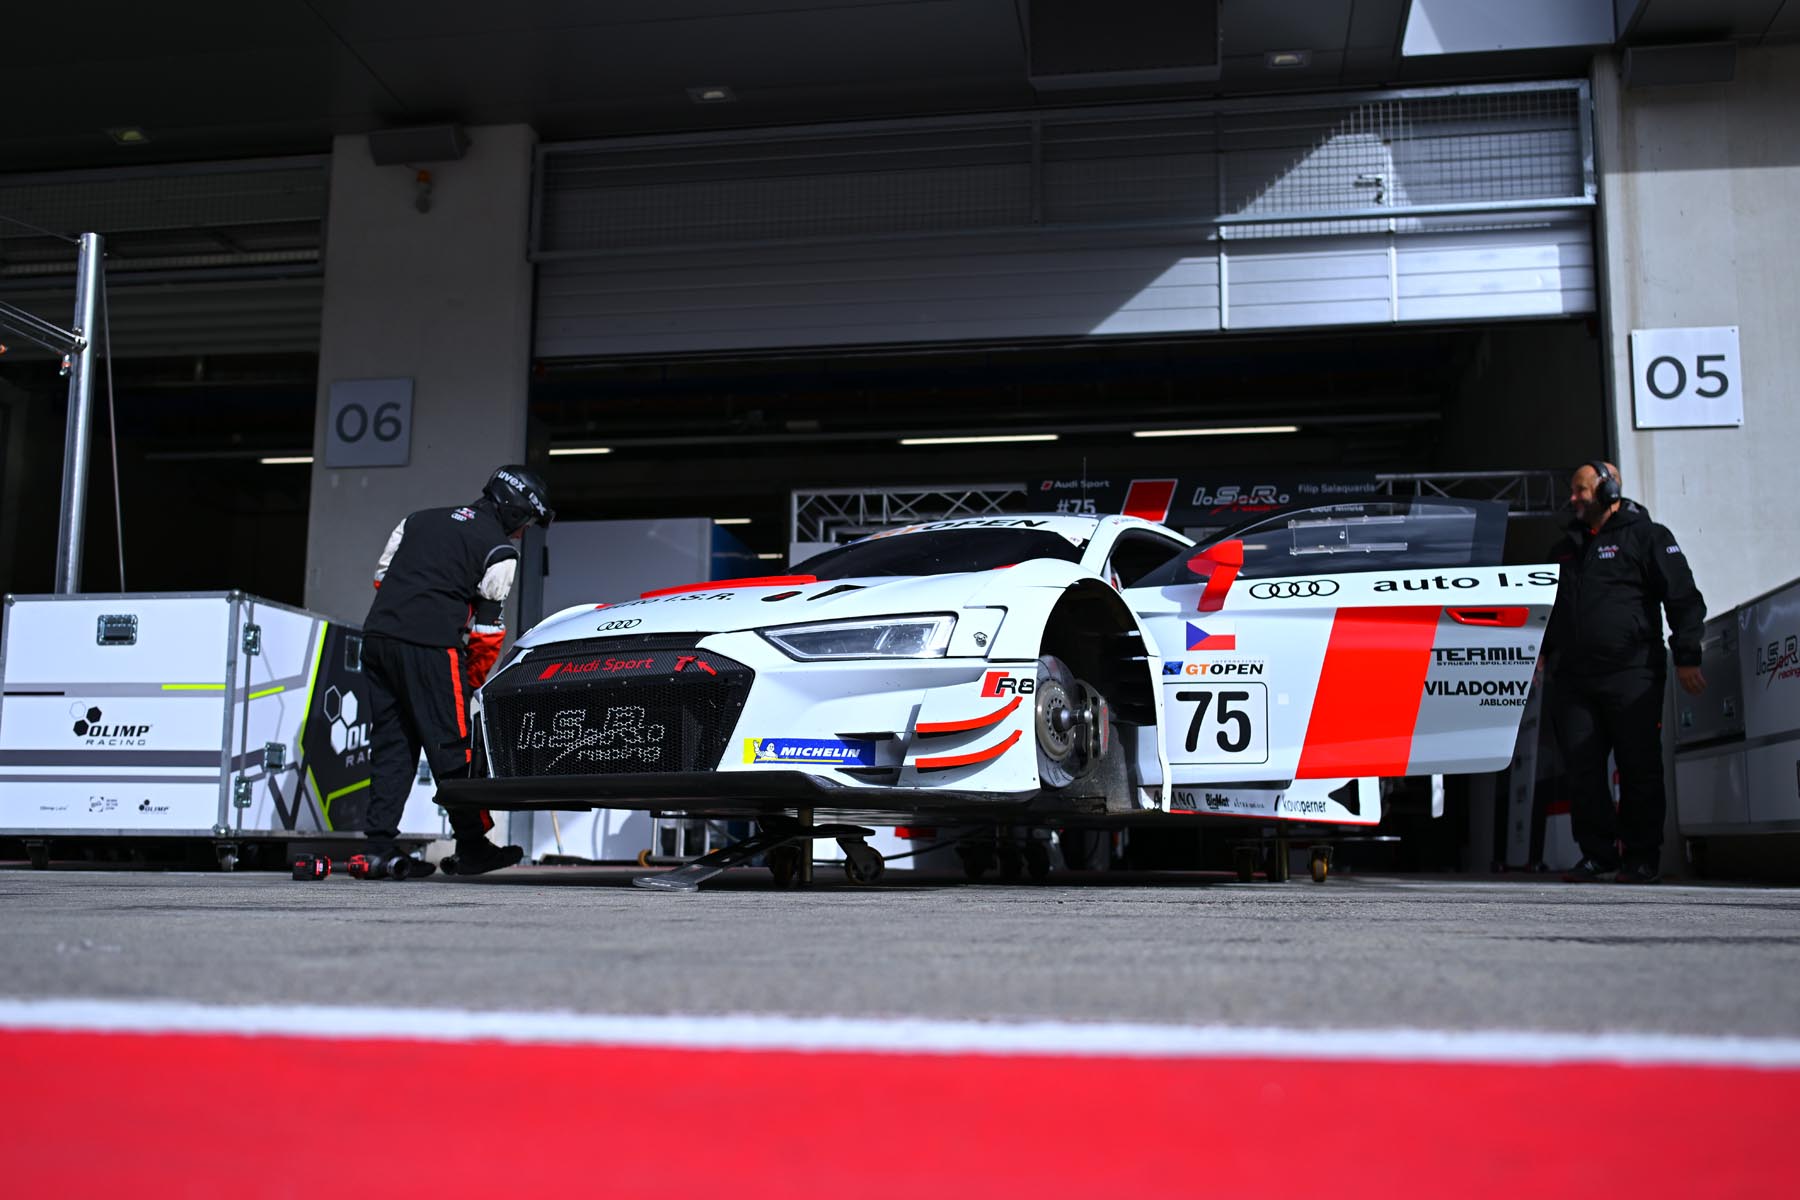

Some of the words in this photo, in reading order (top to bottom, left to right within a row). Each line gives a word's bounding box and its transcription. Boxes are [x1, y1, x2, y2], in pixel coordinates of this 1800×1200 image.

[1646, 355, 1729, 400] 05
[335, 401, 402, 443] 06
[498, 471, 526, 492] uvex
[1054, 480, 1078, 489] Audi
[1080, 480, 1110, 489] Sport
[1298, 483, 1319, 494] Filip
[1056, 499, 1096, 514] #75
[1373, 575, 1480, 592] auto
[1430, 646, 1536, 661] TERMIL
[560, 660, 600, 674] Audi
[602, 657, 654, 672] Sport
[995, 678, 1035, 694] R8
[1424, 680, 1529, 696] VILADOMY
[1175, 691, 1252, 753] 75
[88, 725, 150, 737] OLIMP
[780, 746, 861, 758] MICHELIN
